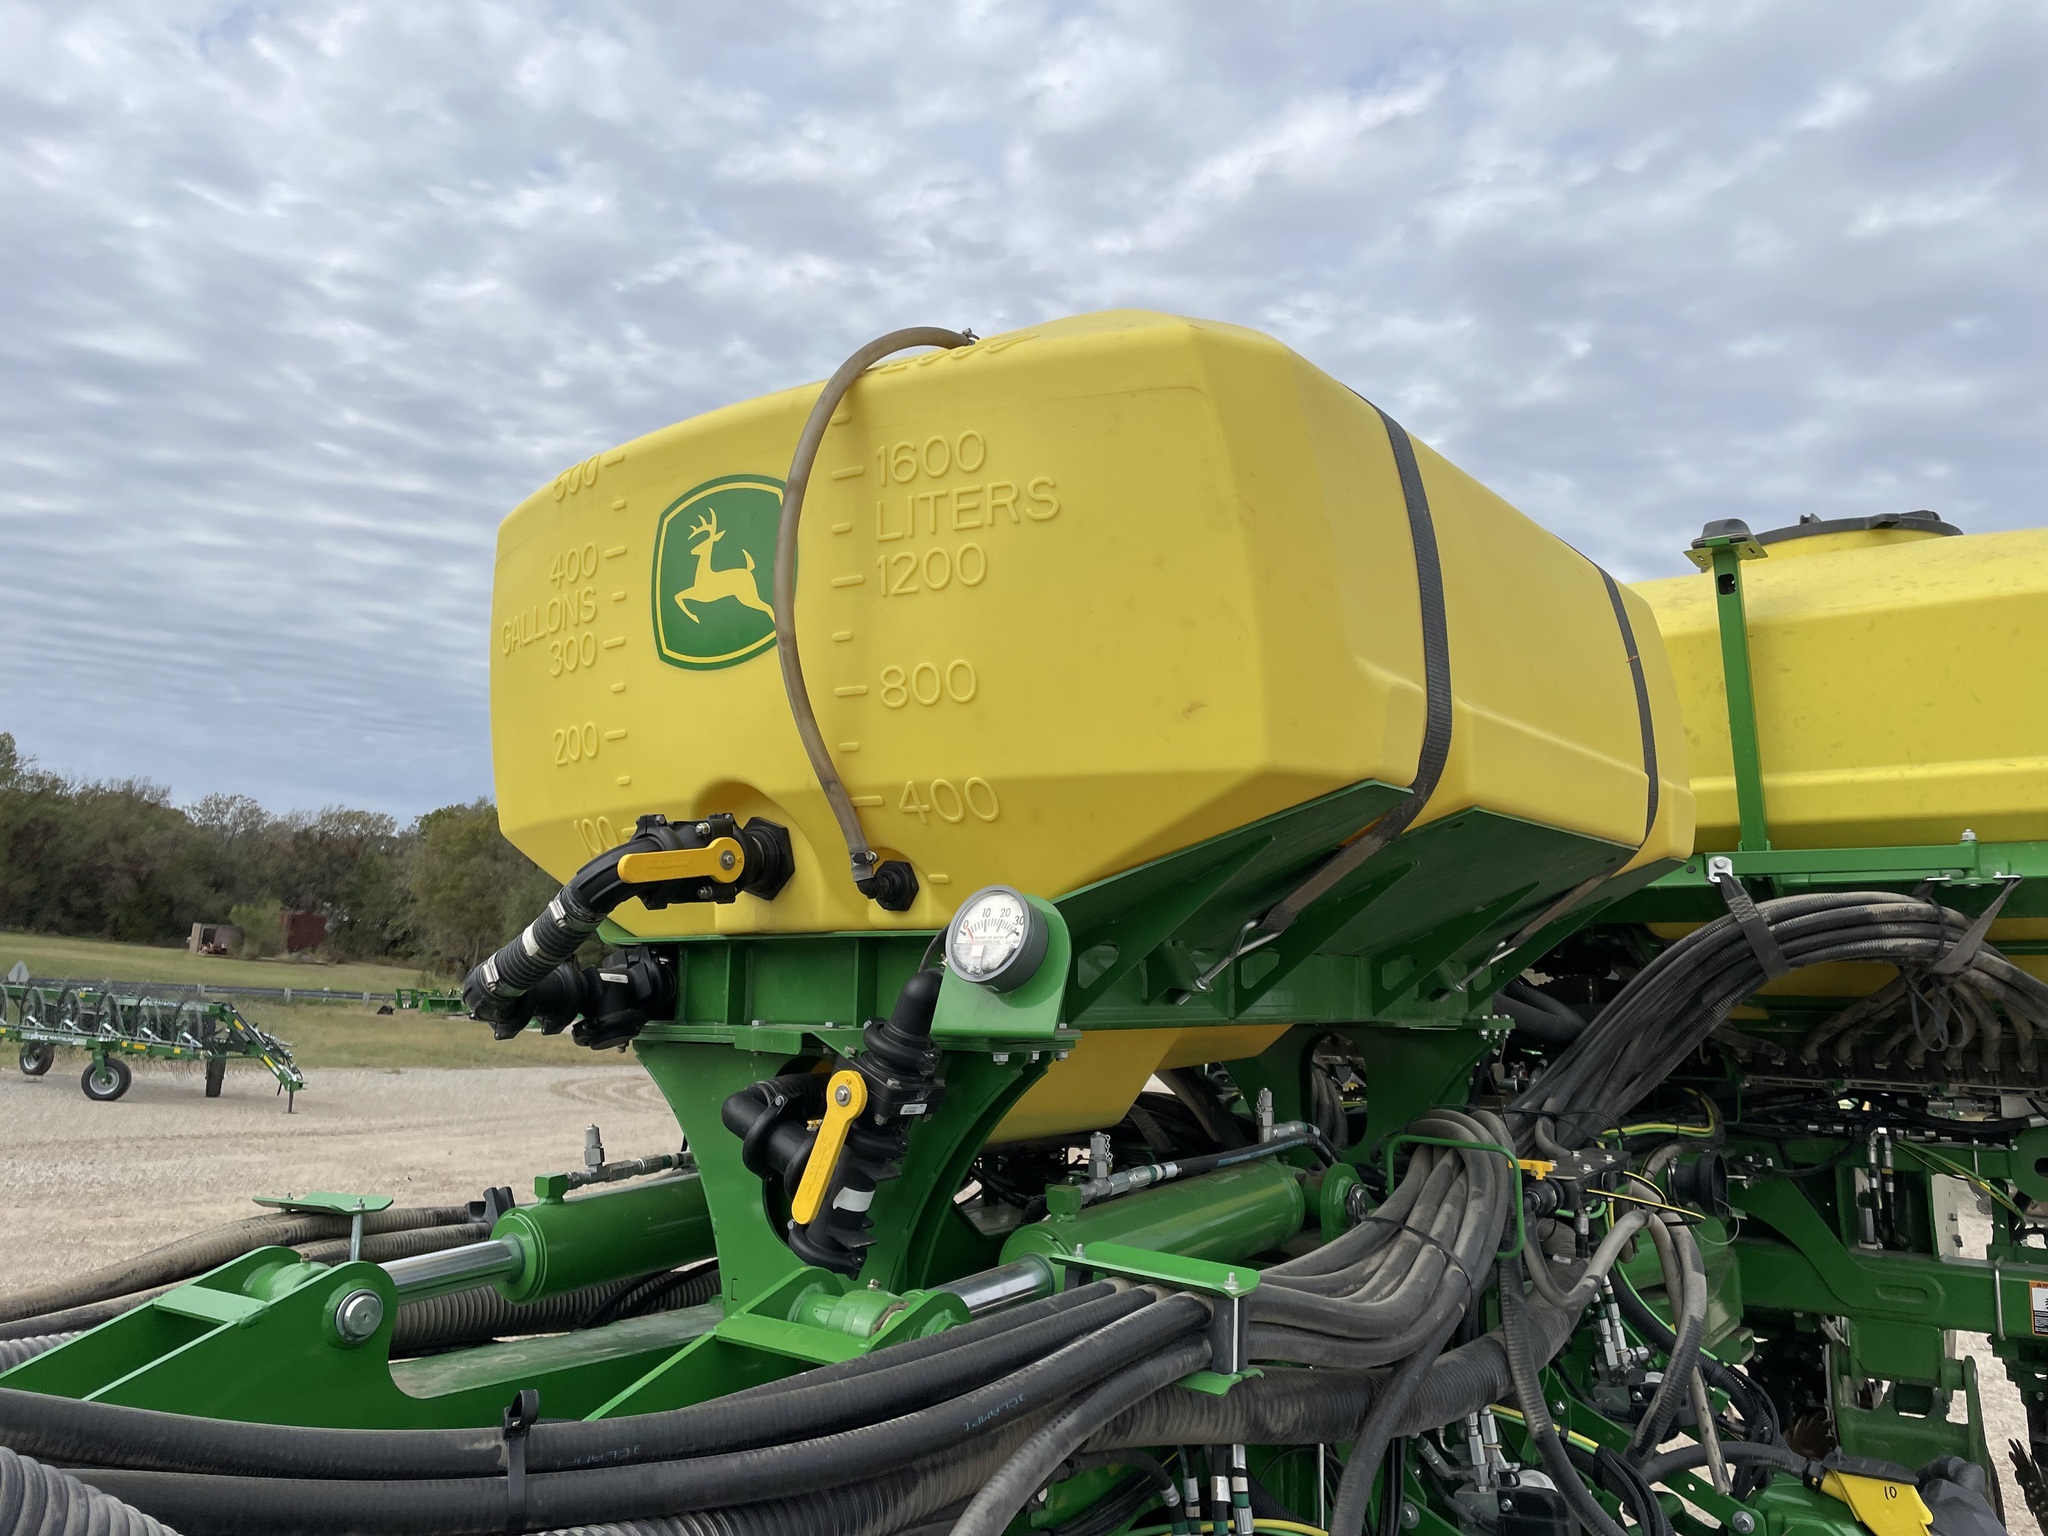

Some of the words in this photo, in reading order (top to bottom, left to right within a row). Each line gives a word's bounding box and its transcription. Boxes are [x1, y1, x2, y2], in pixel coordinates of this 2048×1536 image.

[553, 453, 600, 502] 500
[876, 429, 986, 487] 1600
[876, 476, 1060, 542] LITERS
[549, 542, 599, 589] 400
[876, 542, 987, 597] 1200
[501, 586, 598, 657] GALLONS
[549, 631, 598, 678] 300
[880, 659, 977, 708] 800
[553, 721, 600, 767] 200
[899, 776, 1000, 824] 400
[573, 816, 620, 858] 100
[982, 908, 992, 918] 10
[1000, 907, 1011, 918] 20
[1014, 915, 1024, 926] 30
[1884, 1485, 1898, 1501] 10
